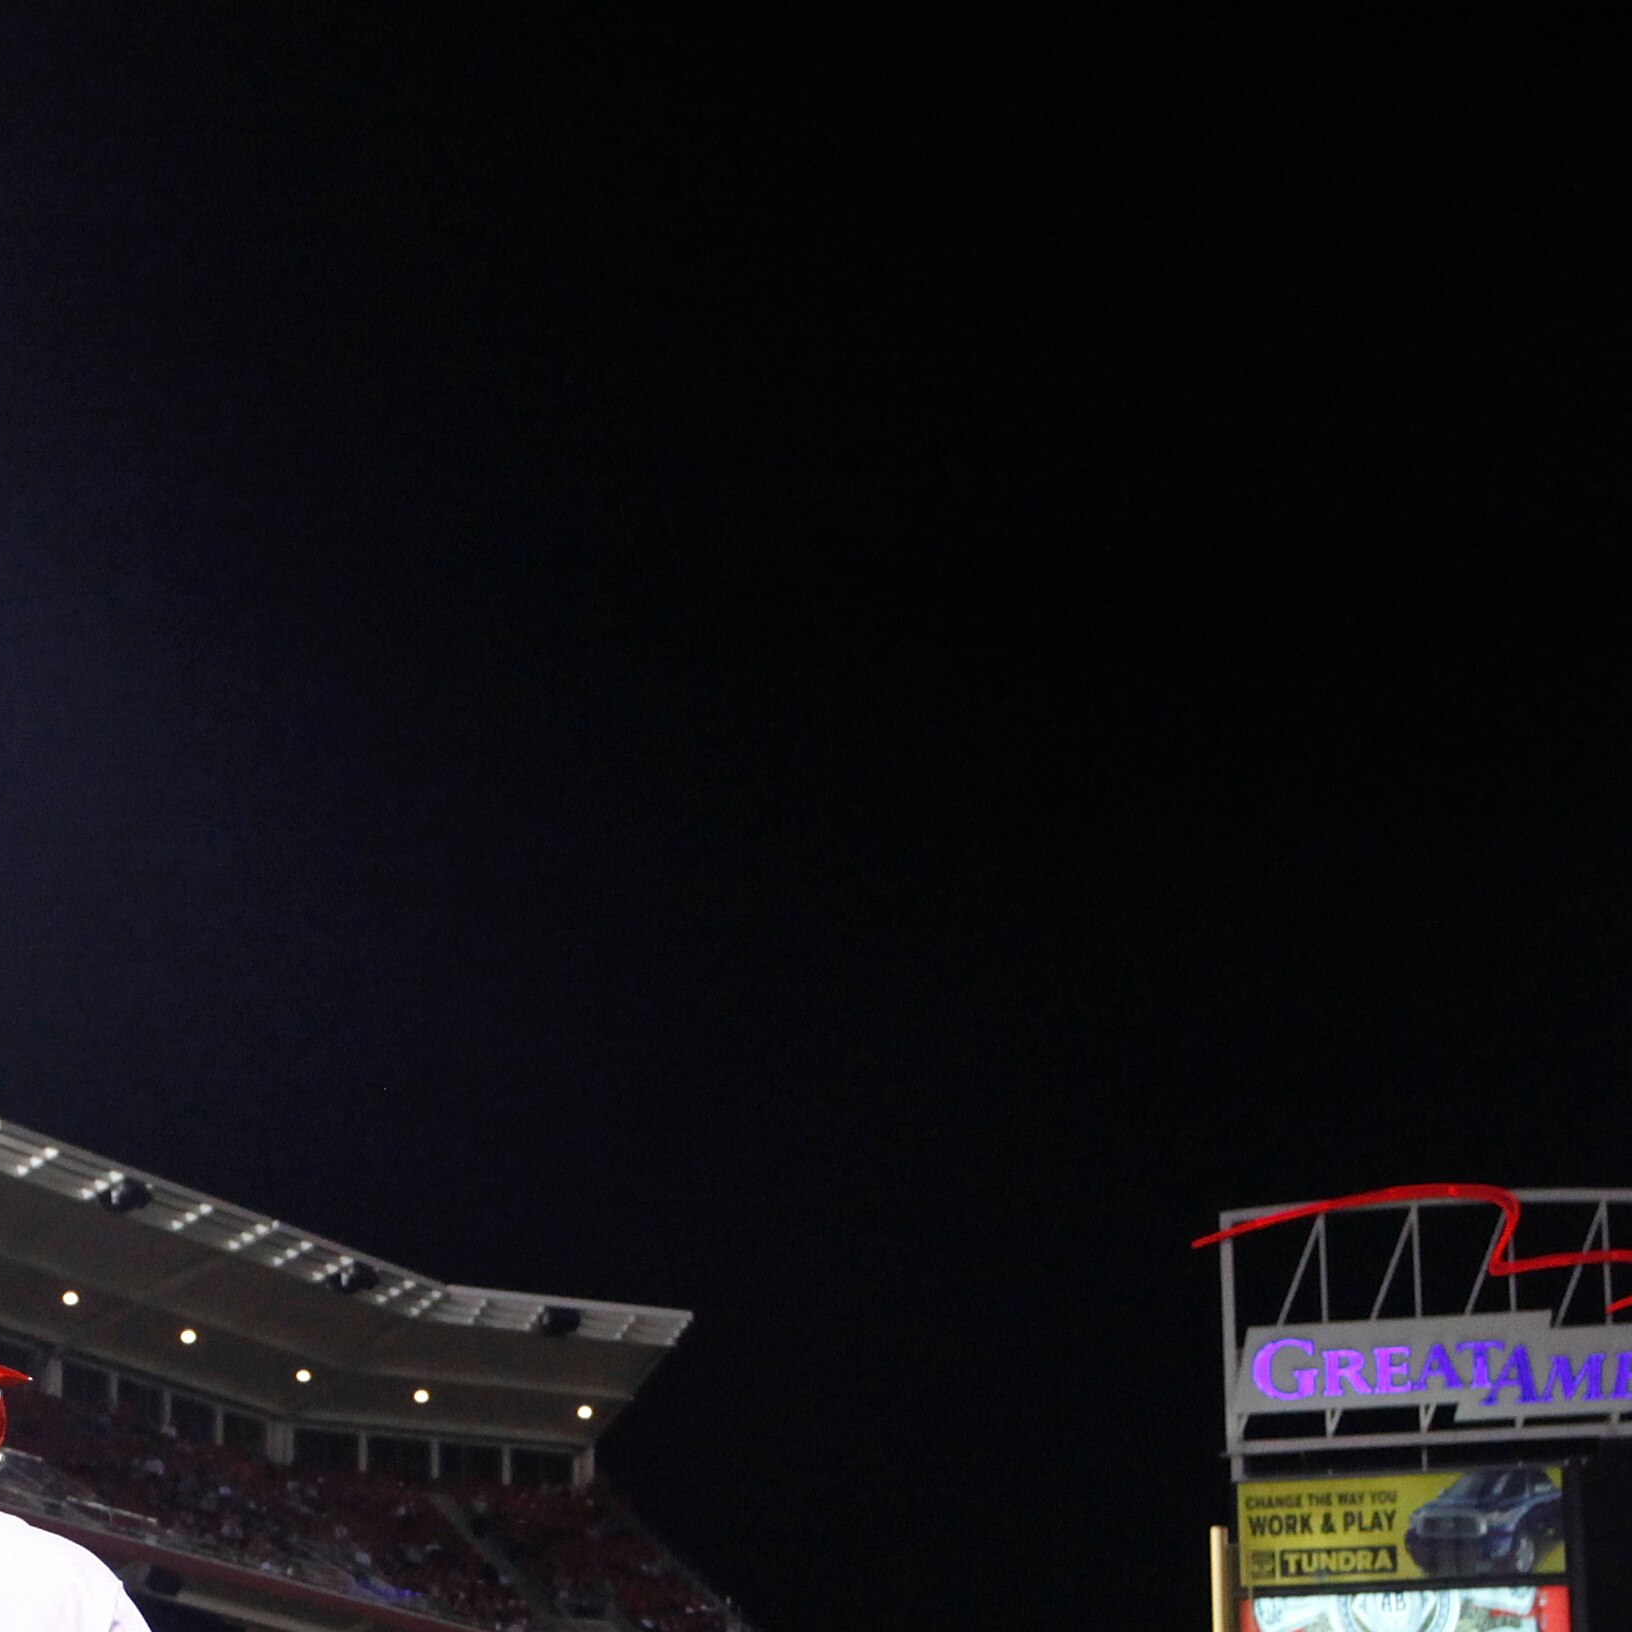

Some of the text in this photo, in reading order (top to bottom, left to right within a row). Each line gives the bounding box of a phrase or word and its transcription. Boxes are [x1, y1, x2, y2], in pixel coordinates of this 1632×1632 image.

[1252, 1338, 1506, 1401] GREAT
[1308, 1493, 1333, 1508] THE
[1338, 1491, 1365, 1507] WAY
[1367, 1490, 1397, 1505] YOU
[1248, 1510, 1396, 1537] WORK & PLAY
[1284, 1550, 1393, 1573] TUNDRA
